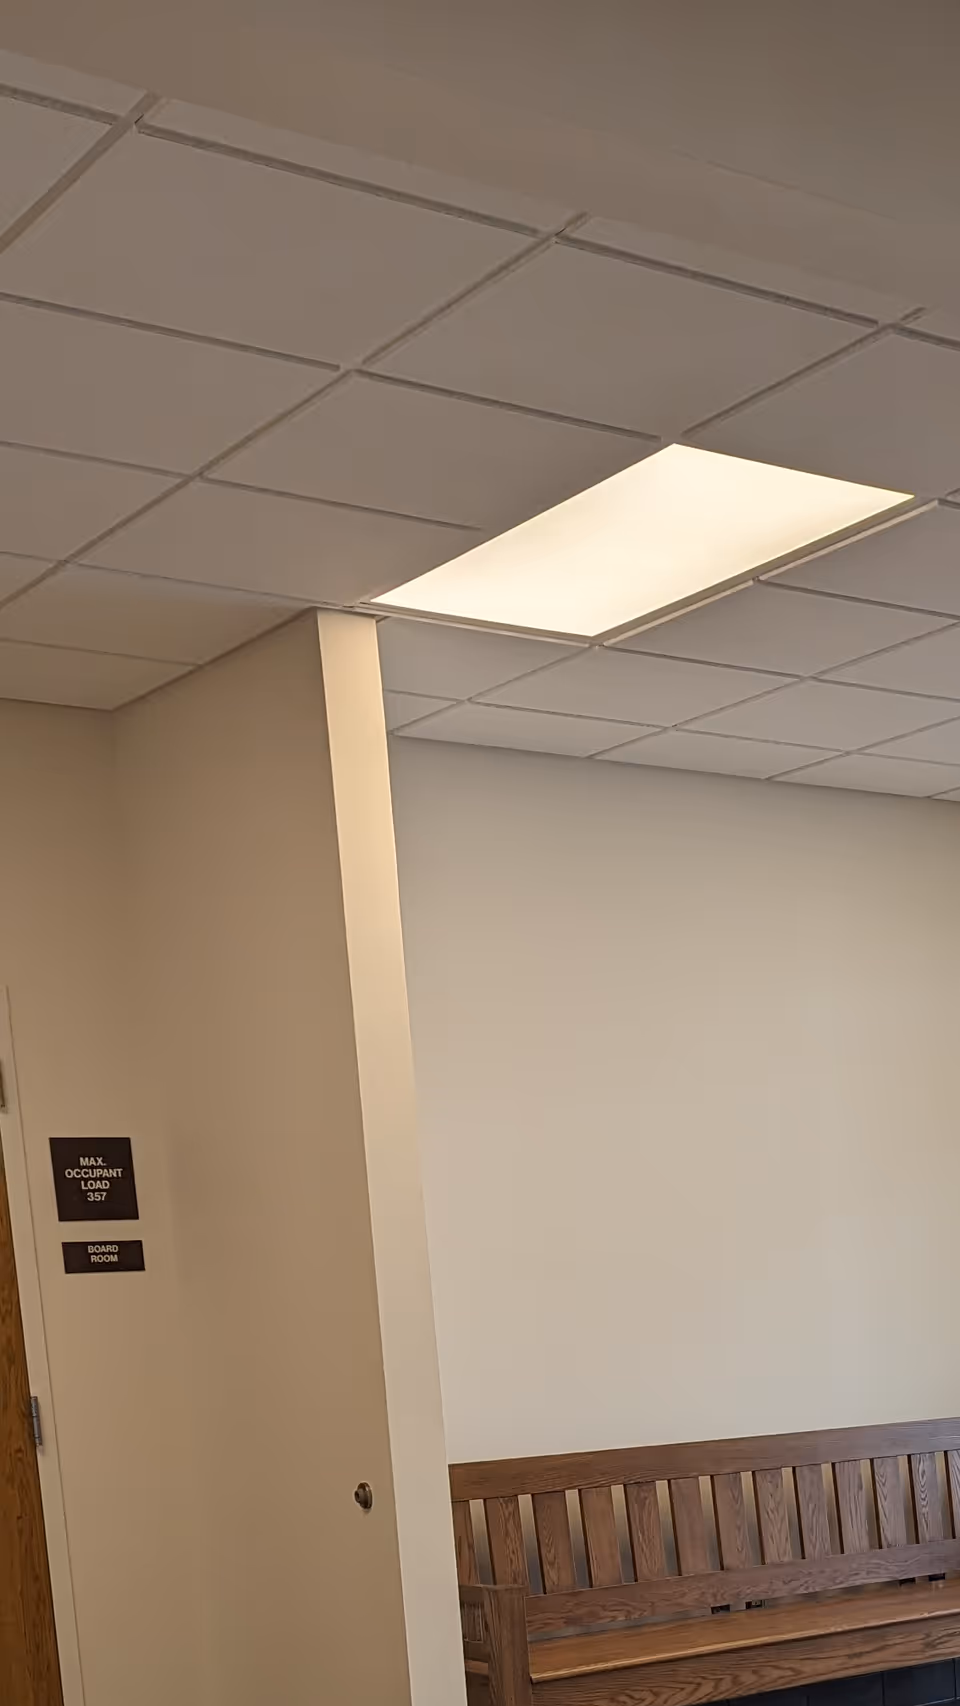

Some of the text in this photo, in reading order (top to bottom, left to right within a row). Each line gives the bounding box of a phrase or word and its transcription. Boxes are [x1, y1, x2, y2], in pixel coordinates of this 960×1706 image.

[79, 1156, 107, 1167] MAX.
[64, 1168, 123, 1178] OCCUPANT
[80, 1180, 110, 1190] LOAD
[86, 1191, 107, 1201] 357
[87, 1245, 119, 1253] BOARD
[90, 1254, 119, 1263] ROOM
